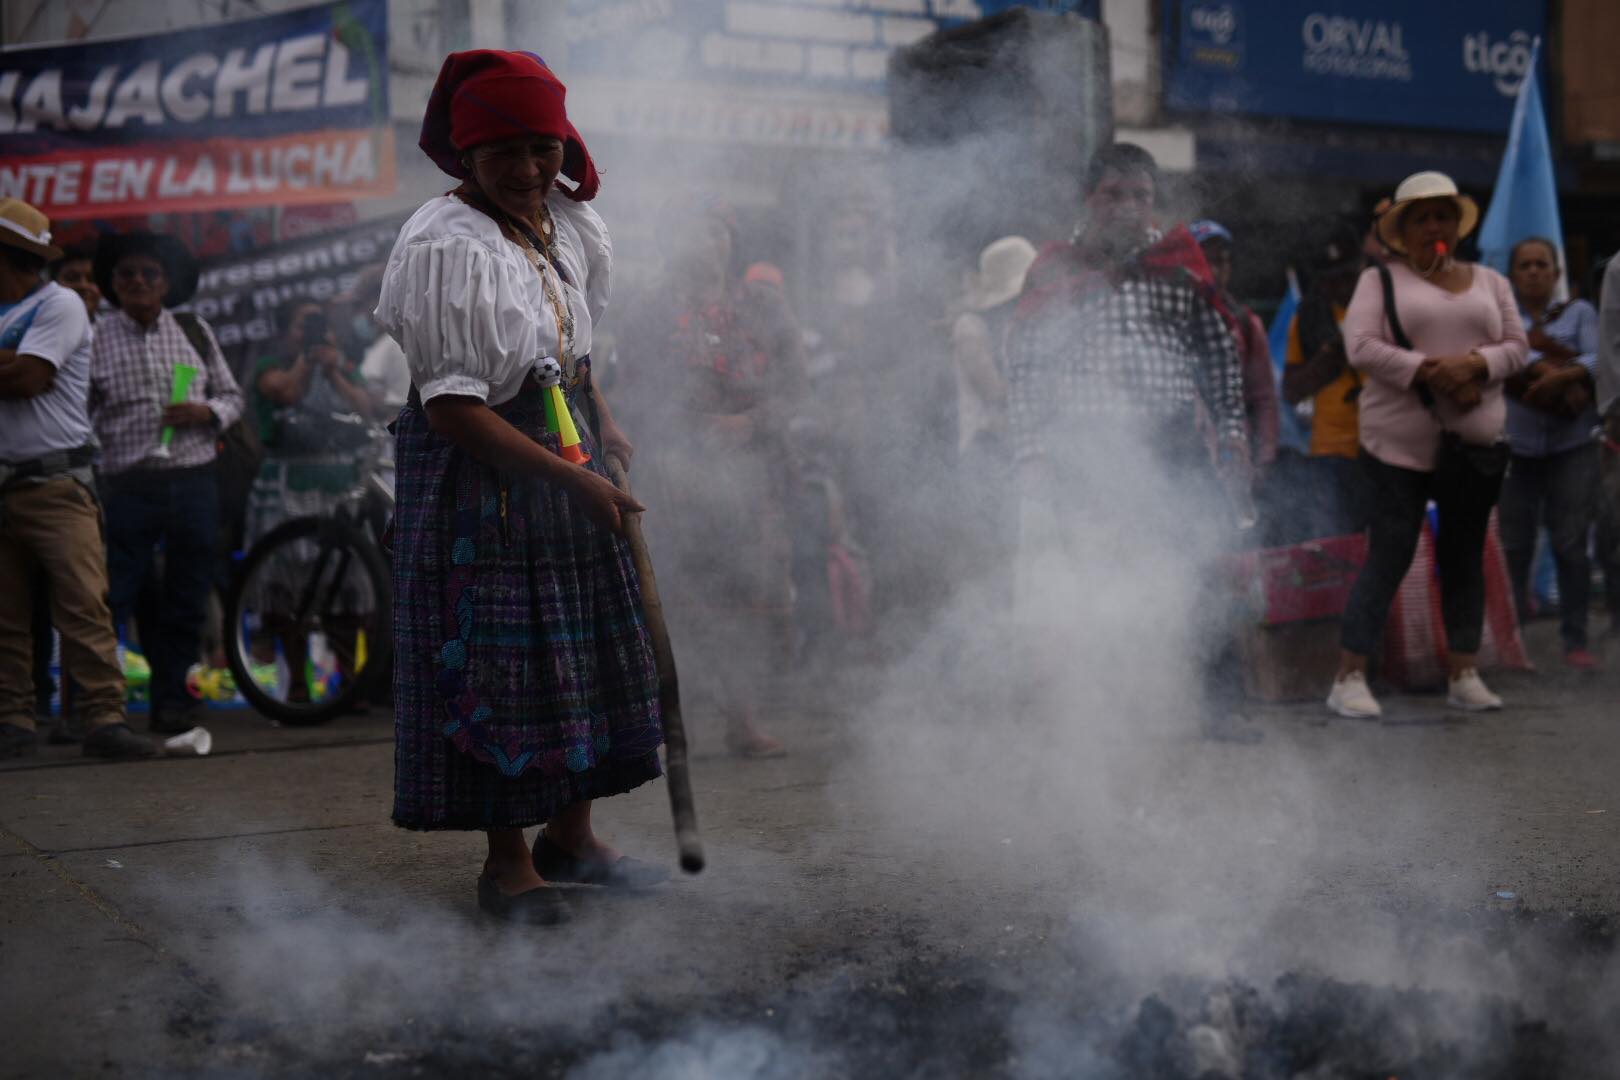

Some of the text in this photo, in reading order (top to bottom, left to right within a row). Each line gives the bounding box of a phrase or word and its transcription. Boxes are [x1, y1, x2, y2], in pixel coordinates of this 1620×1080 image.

[1302, 13, 1410, 58] ORVAL
[88, 160, 158, 203] EN
[158, 157, 217, 198] LA
[226, 137, 377, 193] LUCHA
